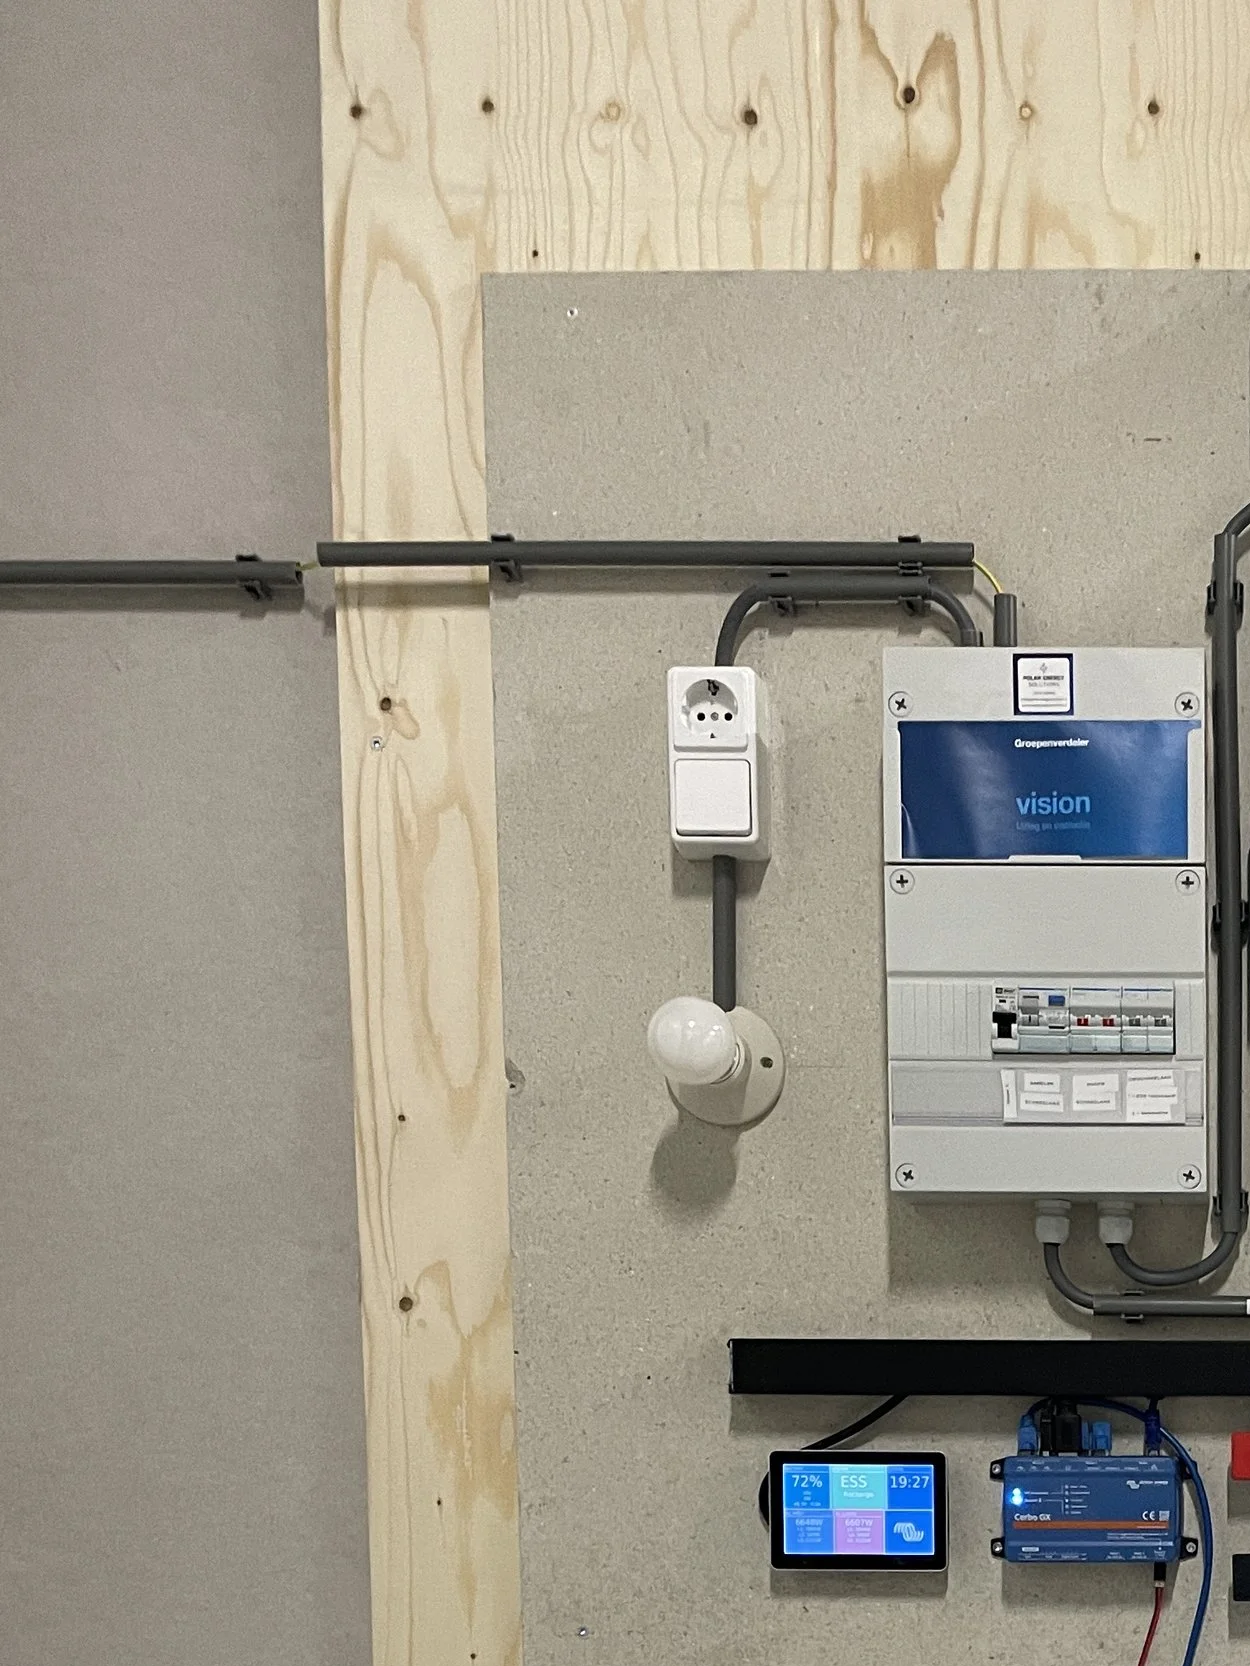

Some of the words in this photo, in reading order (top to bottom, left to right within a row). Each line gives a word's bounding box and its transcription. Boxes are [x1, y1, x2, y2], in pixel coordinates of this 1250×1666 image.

[1014, 738, 1090, 749] Groepenverdeler
[1016, 791, 1091, 815] vision
[791, 1474, 823, 1488] 72%
[840, 1475, 868, 1488] ESS
[889, 1475, 930, 1489] 19:27
[1013, 1512, 1038, 1521] Cerbo
[1039, 1512, 1052, 1521] GX
